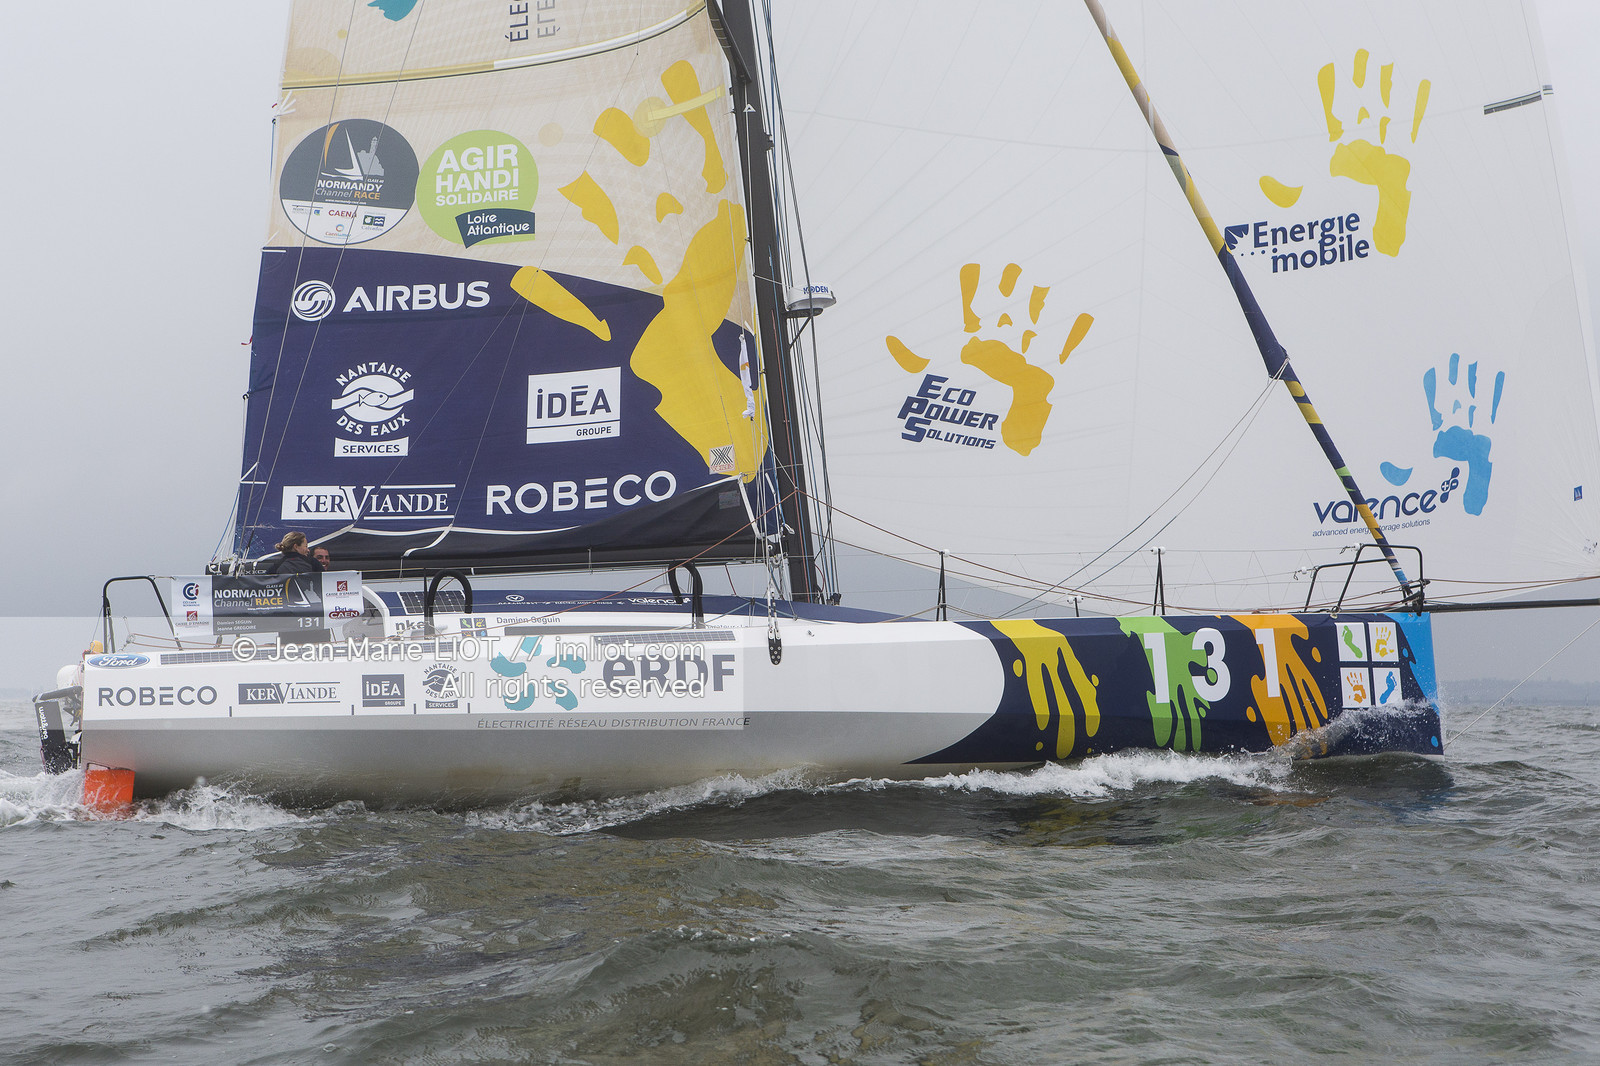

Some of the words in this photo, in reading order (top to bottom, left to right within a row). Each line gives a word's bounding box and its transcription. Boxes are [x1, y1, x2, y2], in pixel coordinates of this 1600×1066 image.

[436, 144, 518, 173] AGIR
[317, 180, 383, 192] NORMANDY
[436, 168, 519, 193] HANDI
[315, 188, 352, 198] Channel
[354, 191, 381, 200] RACE
[436, 189, 519, 206] SOLIDAIRE
[467, 213, 497, 224] Loire
[467, 223, 530, 236] Atlantique
[1253, 213, 1360, 248] Energie
[1271, 234, 1370, 273] mobile
[342, 281, 490, 312] AIRBUS
[335, 362, 412, 387] NANTAISE
[336, 415, 364, 435] DES
[370, 413, 411, 436] EAUX
[576, 426, 612, 436] GROUPE
[342, 445, 400, 454] SERVICES
[486, 470, 677, 516] ROBECO
[1312, 527, 1348, 537] advanced
[1401, 518, 1431, 529] solutions
[214, 588, 283, 599] NORMANDY
[214, 598, 253, 607] Channel
[255, 597, 283, 606] RACE
[297, 617, 320, 628] 131
[496, 616, 529, 624] Damien
[531, 616, 561, 625] Seguin
[98, 655, 139, 667] Ford
[1143, 627, 1281, 704] 131
[424, 663, 457, 674] NANTAISE
[98, 685, 218, 707] ROBECO
[426, 688, 438, 698] DES
[477, 717, 555, 729] ÉLECTRICITÉ
[558, 716, 608, 729] RÉSEAU
[611, 718, 699, 728] DISTRIBUTION
[702, 717, 751, 727] FRANCE
